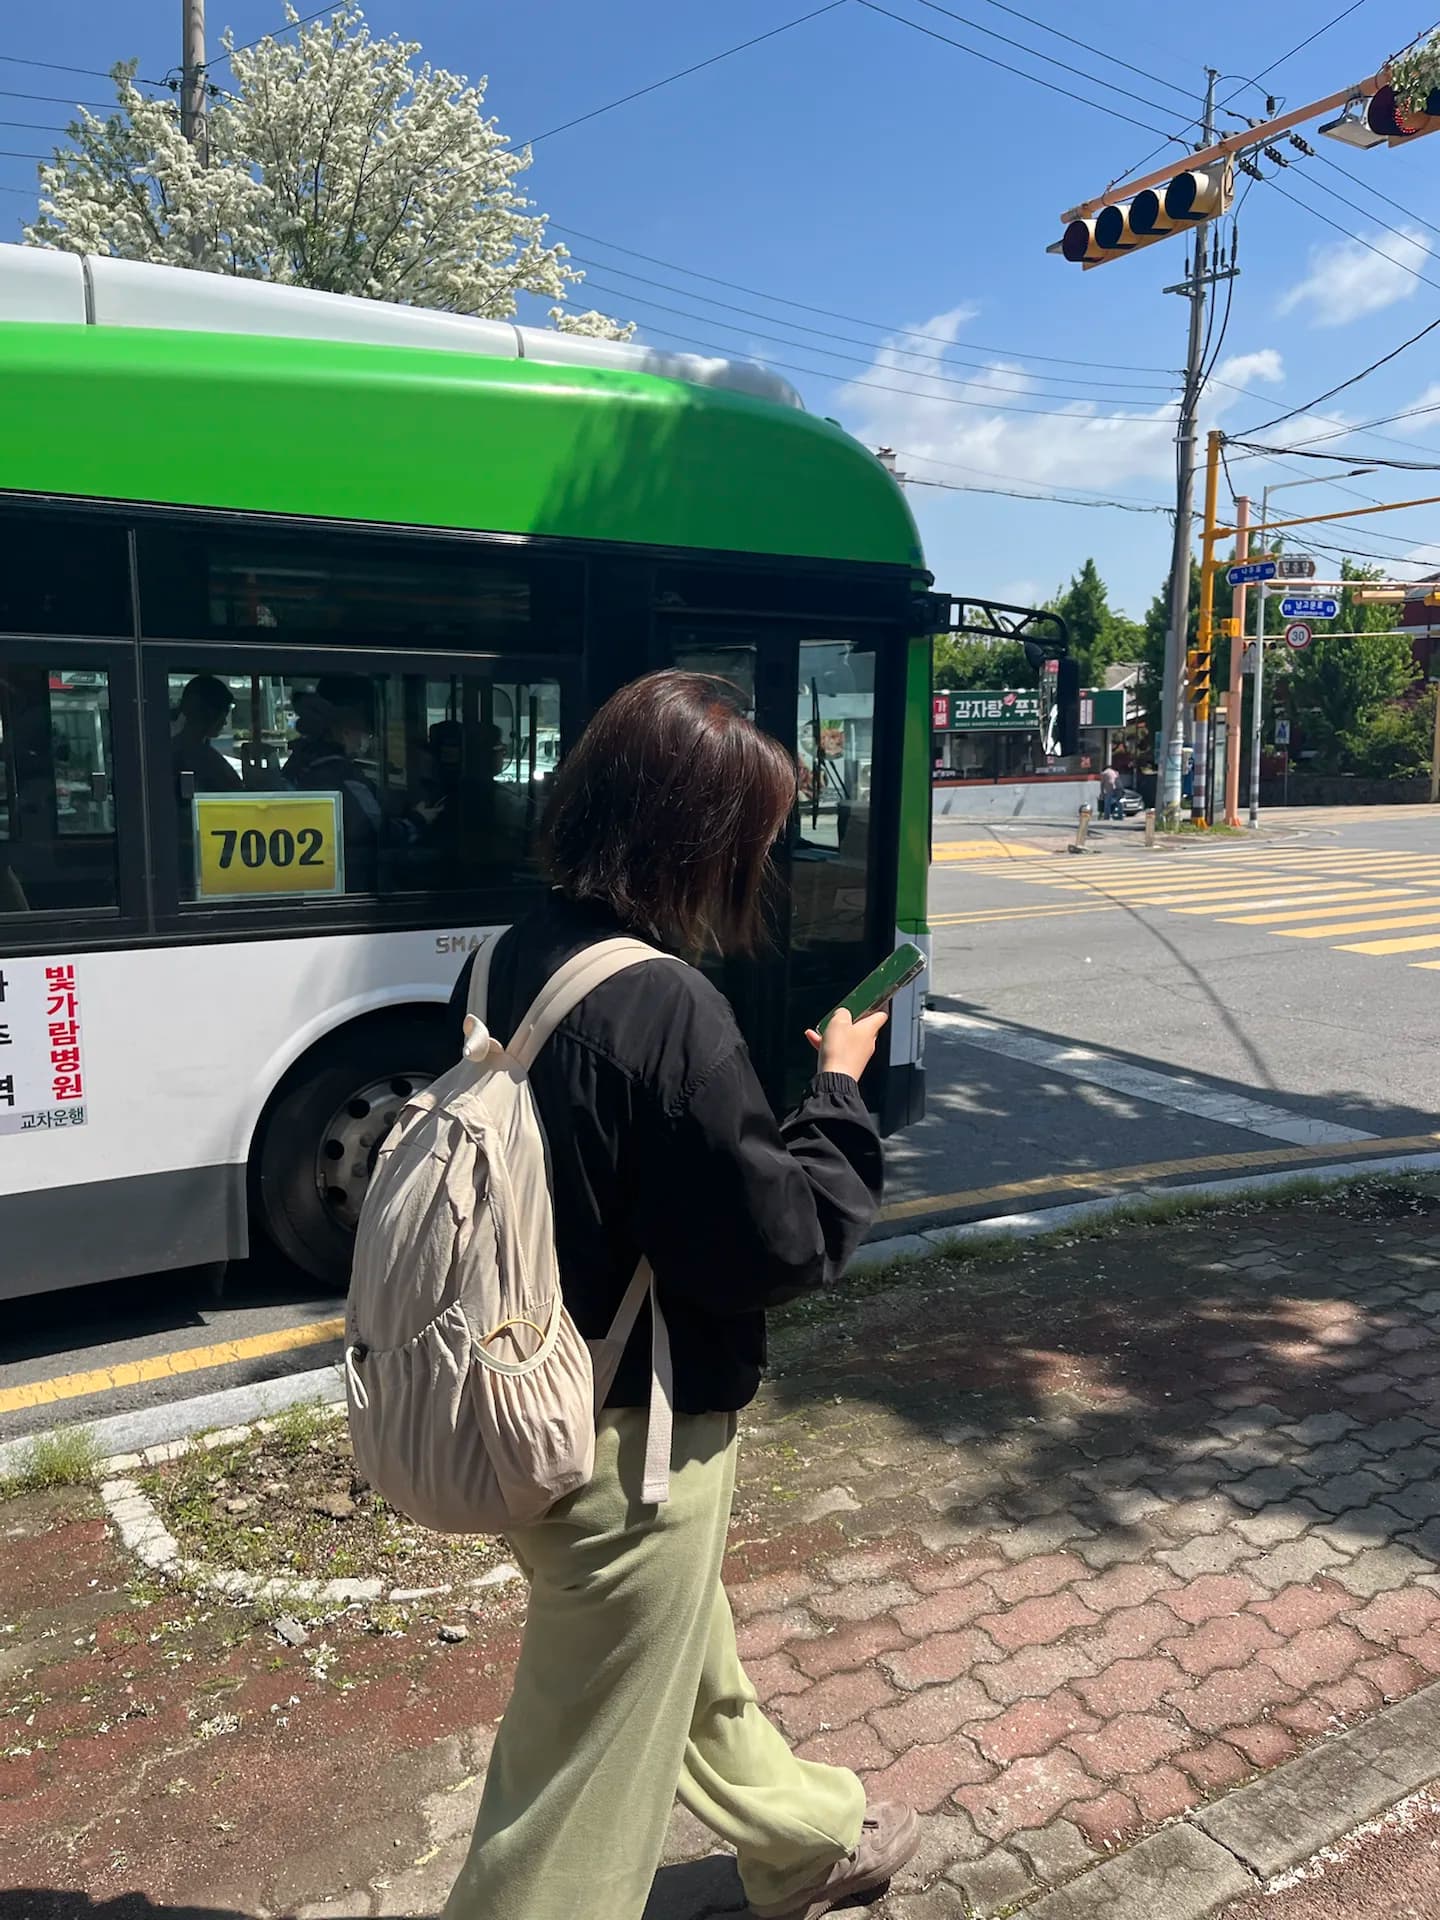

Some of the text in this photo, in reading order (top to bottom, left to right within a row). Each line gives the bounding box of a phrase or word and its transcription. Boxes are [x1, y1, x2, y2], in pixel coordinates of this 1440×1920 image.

[1291, 631, 1305, 642] 30
[955, 700, 1003, 718] 감자탕
[210, 827, 324, 869] 7002
[45, 964, 83, 1101] 빛가람병원
[20, 1106, 84, 1130] 교차운행
